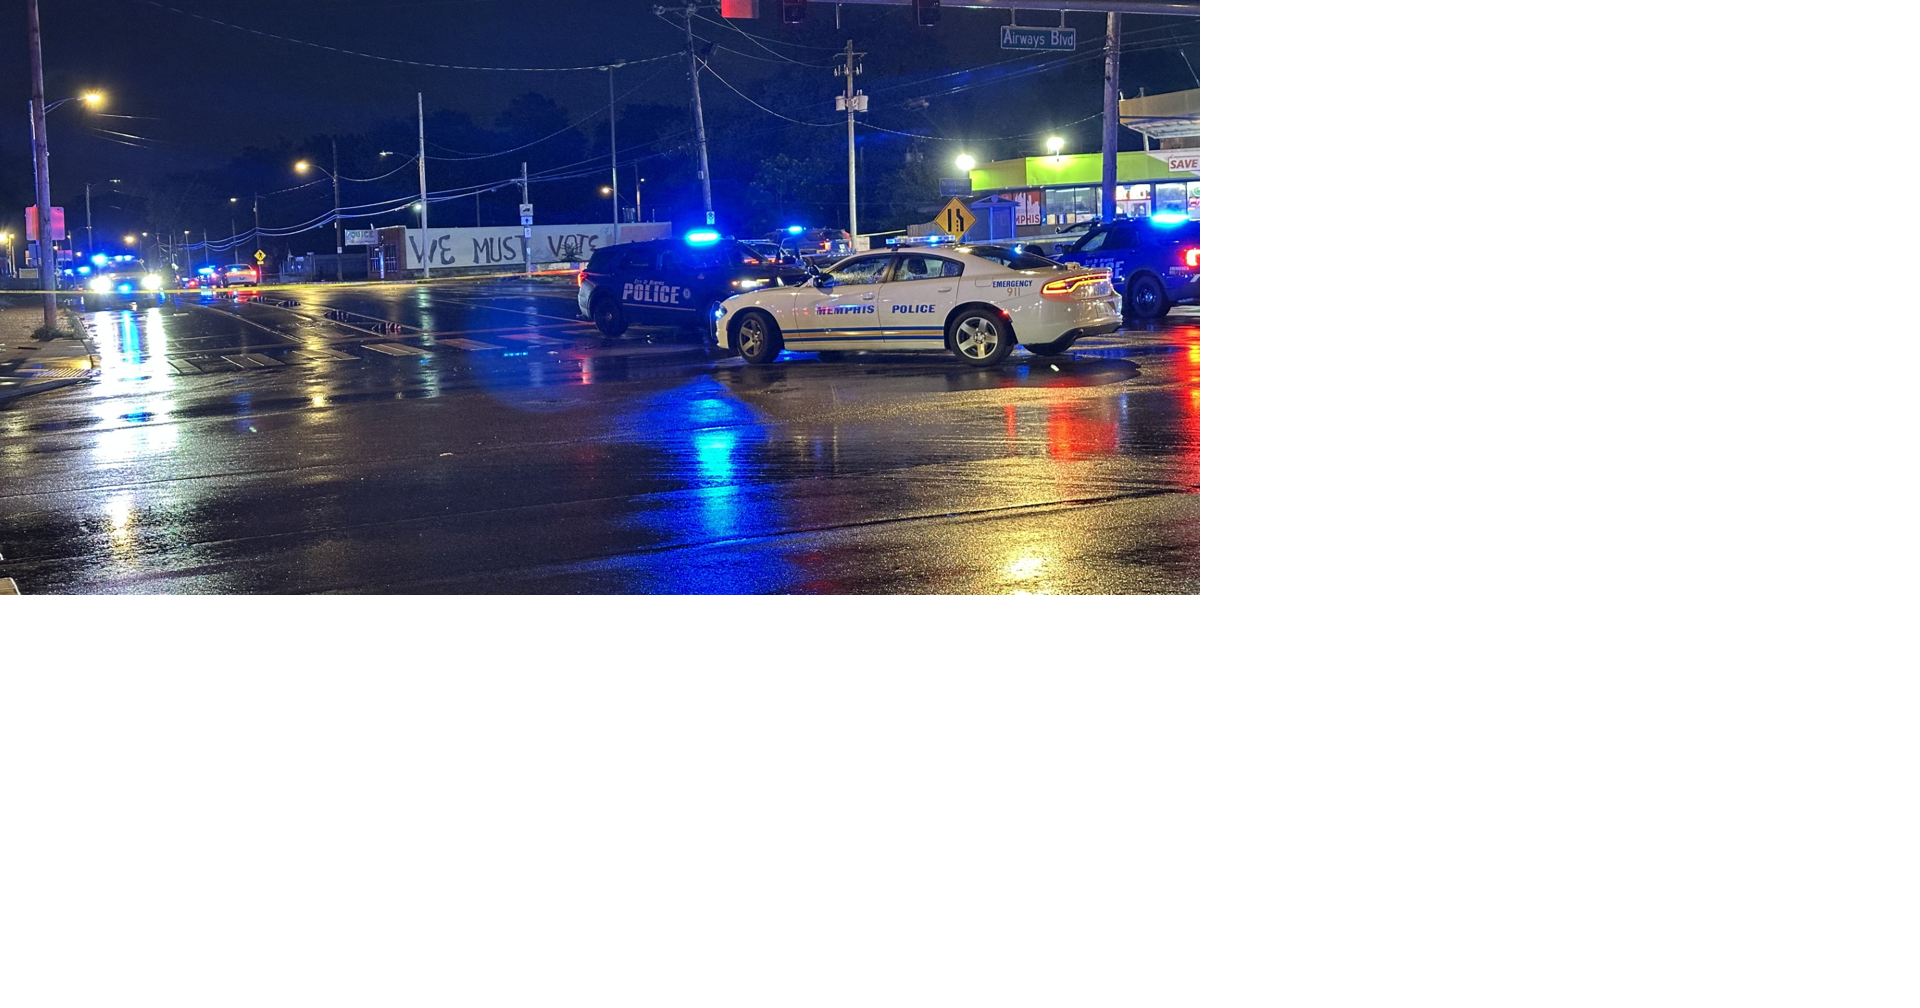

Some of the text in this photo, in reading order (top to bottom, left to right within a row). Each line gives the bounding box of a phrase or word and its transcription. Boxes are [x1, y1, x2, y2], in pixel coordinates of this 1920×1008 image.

[1003, 28, 1074, 48] Airways Blvd
[1169, 159, 1198, 169] SAVE
[408, 233, 600, 265] WE MUST VOTE
[992, 280, 1033, 288] EMERGENCY
[622, 283, 681, 304] POLICE
[1006, 287, 1021, 297] 911
[816, 304, 936, 316] MEMPHIS POLICE
